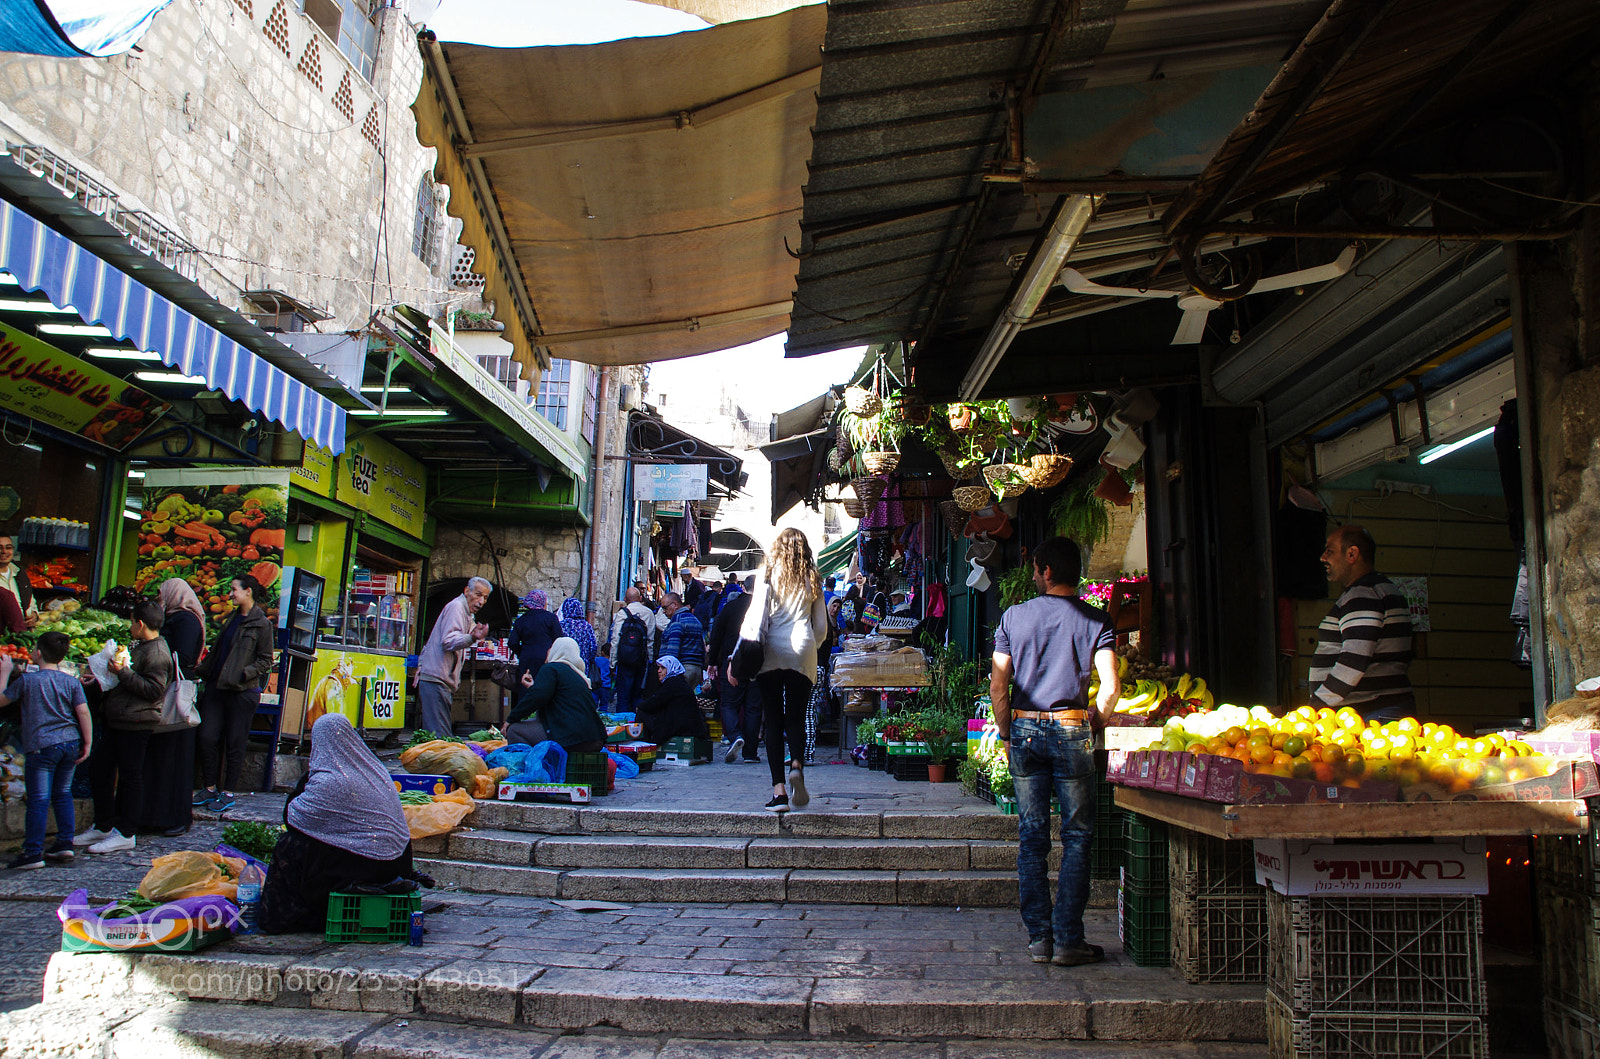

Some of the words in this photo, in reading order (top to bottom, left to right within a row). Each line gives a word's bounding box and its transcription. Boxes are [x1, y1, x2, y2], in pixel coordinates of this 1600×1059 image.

[353, 454, 378, 482] FUZE
[650, 466, 692, 482] صراف
[352, 471, 369, 495] tea
[374, 681, 400, 701] FUZE
[373, 701, 392, 718] tea
[106, 932, 127, 940] BNEI
